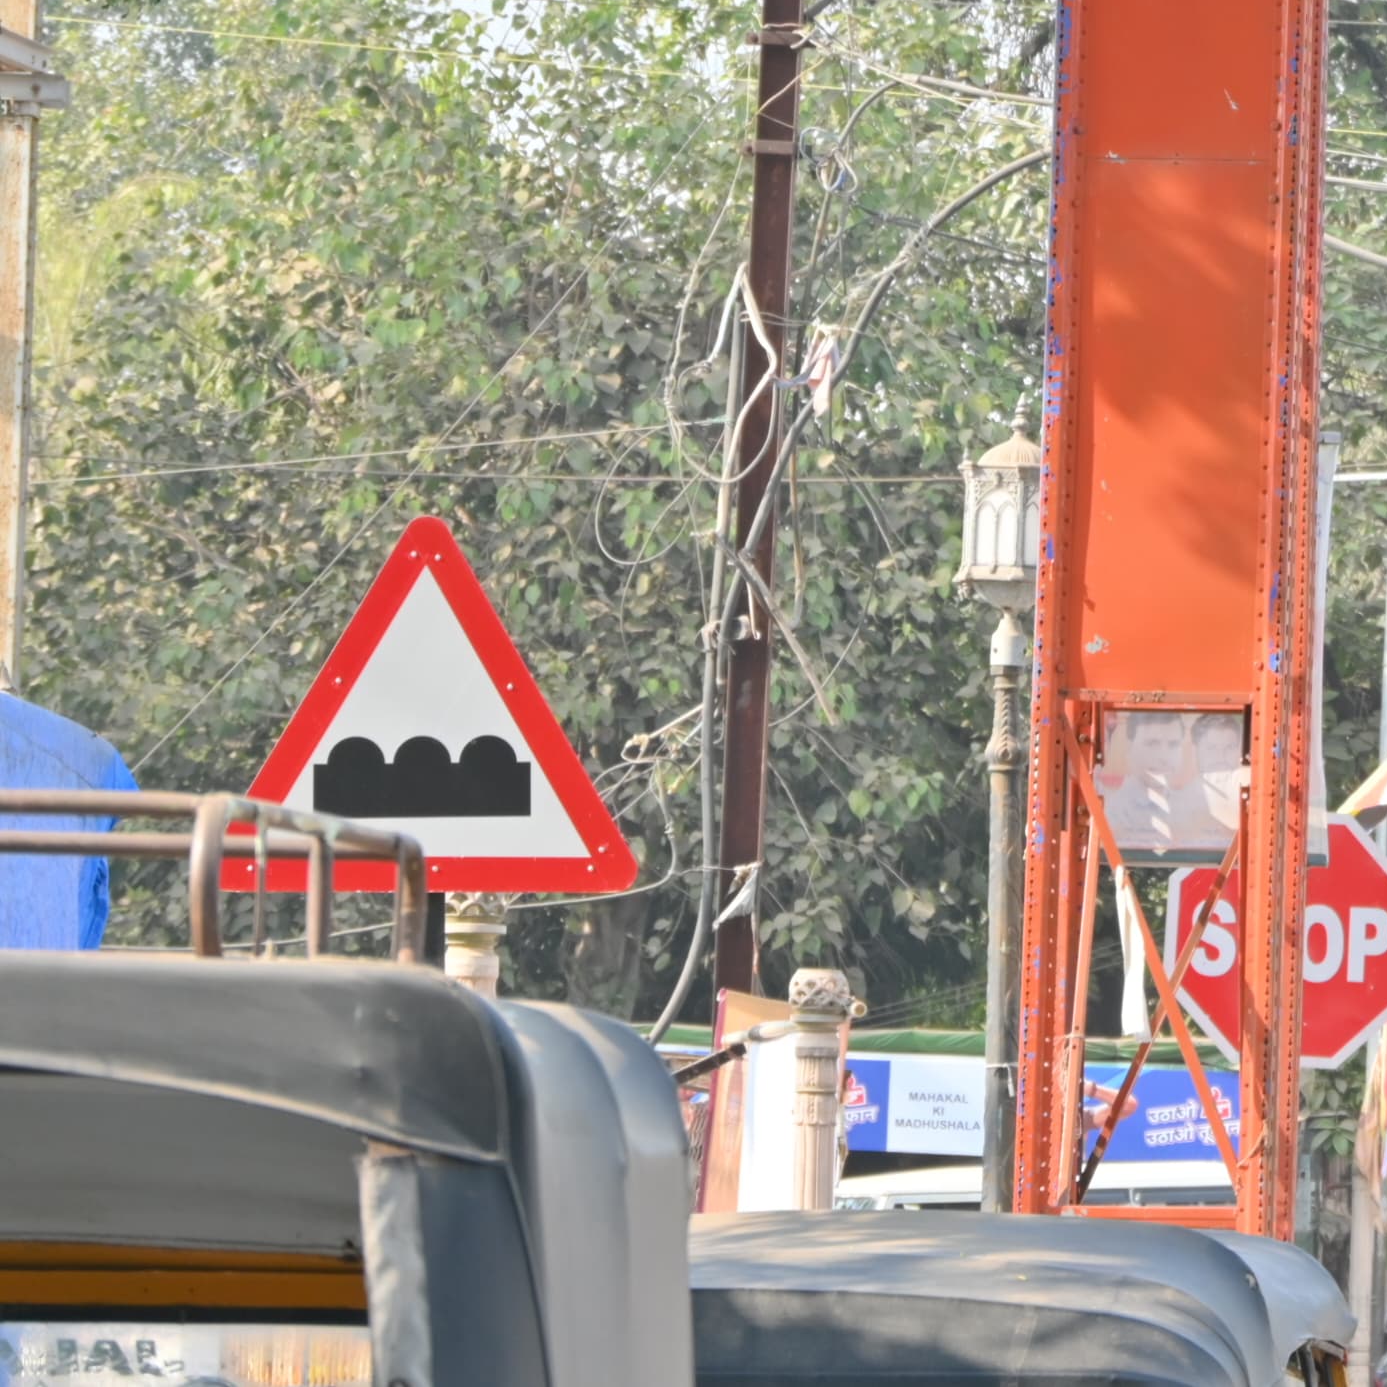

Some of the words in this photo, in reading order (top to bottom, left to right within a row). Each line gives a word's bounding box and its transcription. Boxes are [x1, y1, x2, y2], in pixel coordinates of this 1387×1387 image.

[908, 1092, 968, 1104] MAHAKAL
[932, 1107, 945, 1117] KI
[895, 1118, 980, 1131] MADHUSHALA
